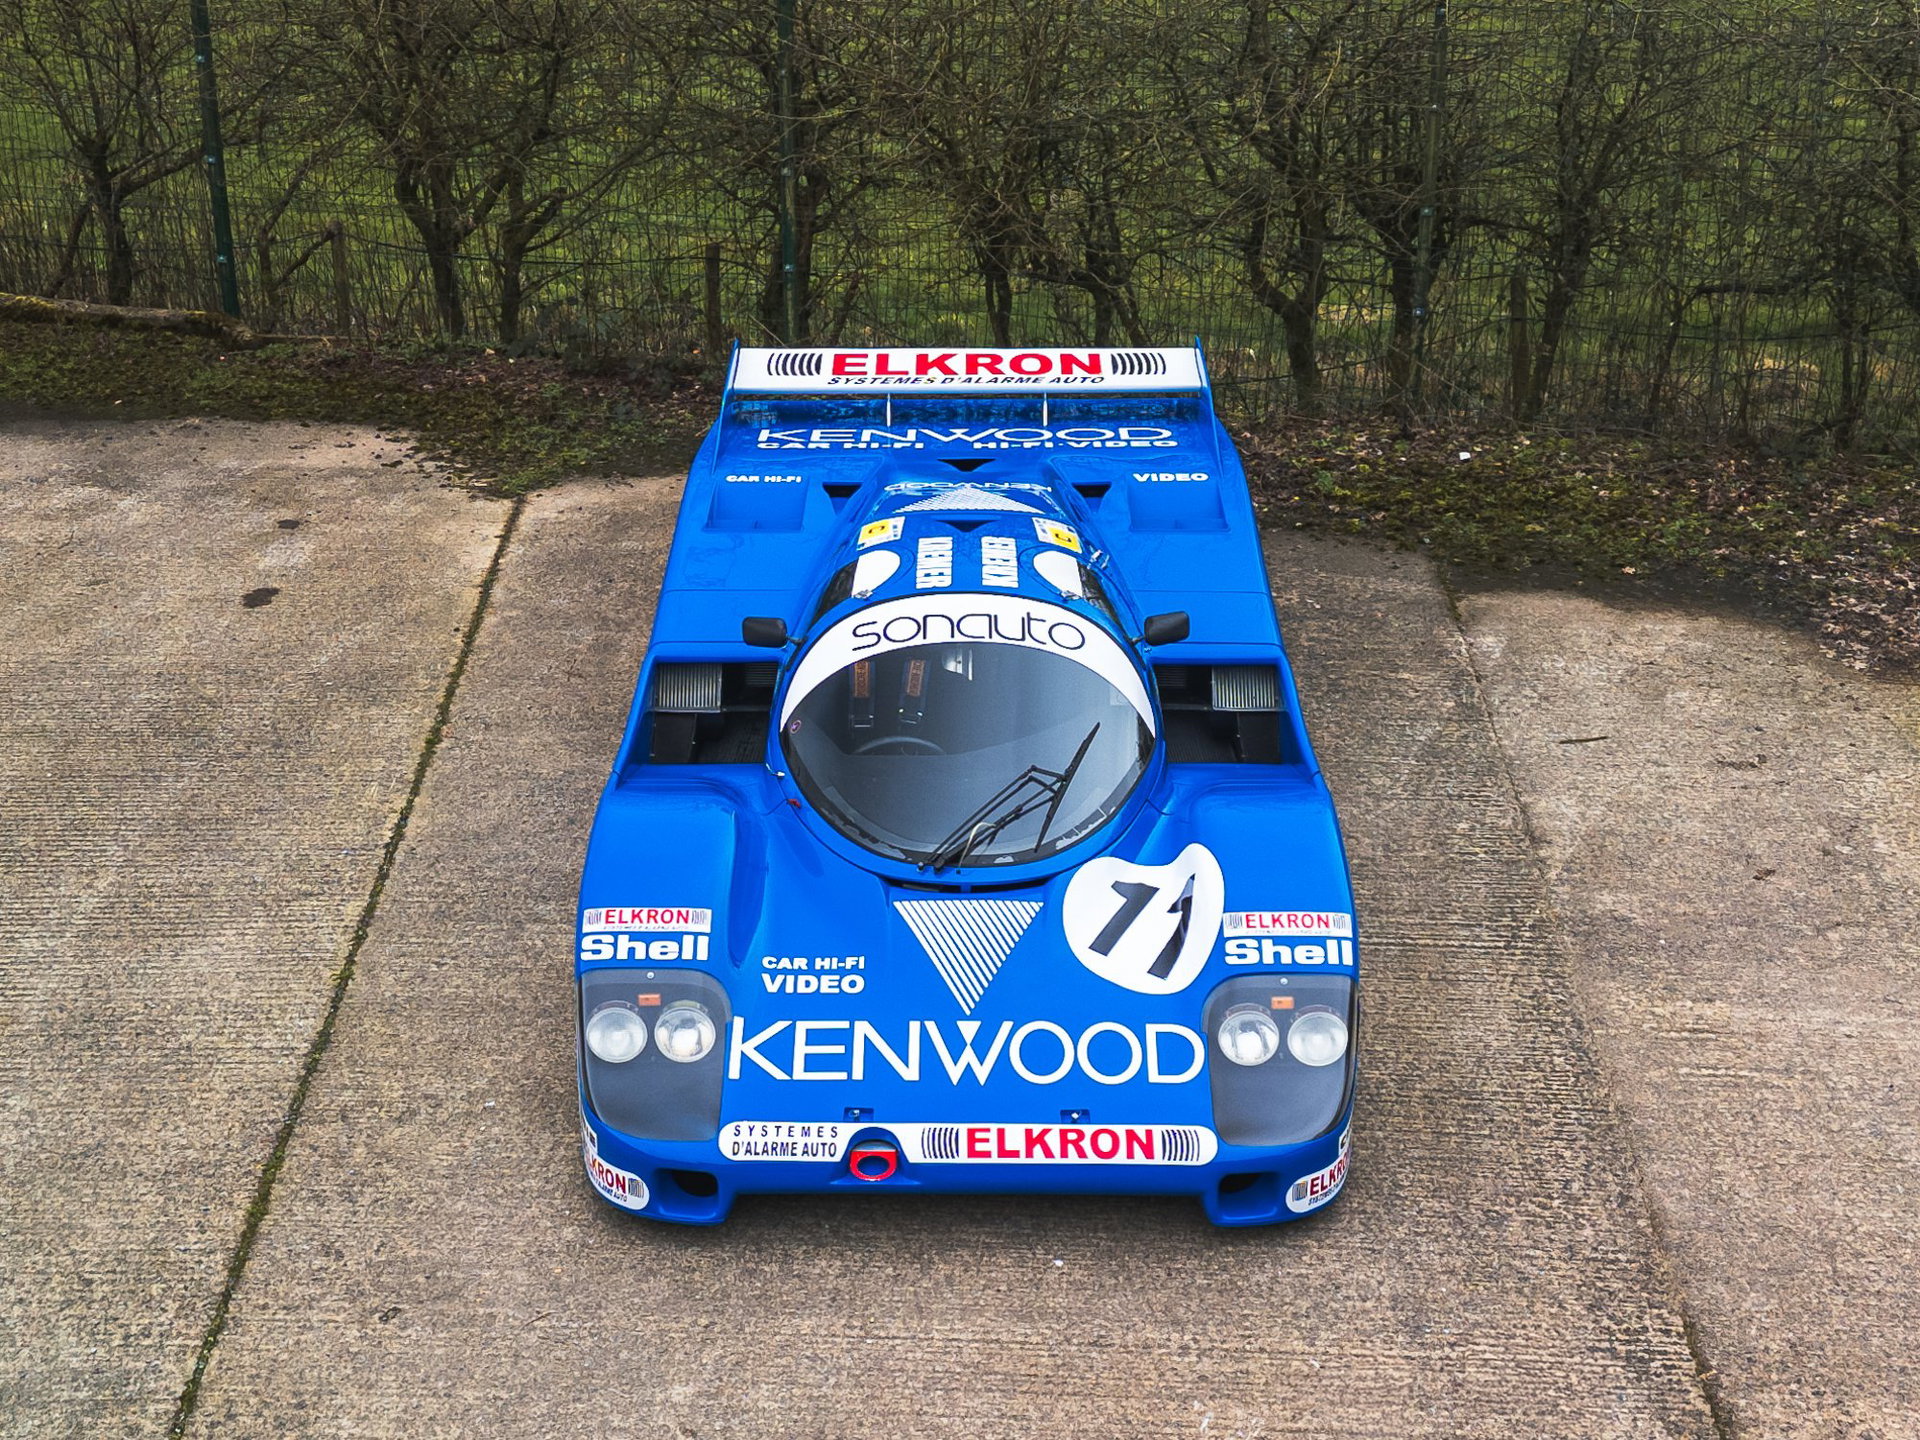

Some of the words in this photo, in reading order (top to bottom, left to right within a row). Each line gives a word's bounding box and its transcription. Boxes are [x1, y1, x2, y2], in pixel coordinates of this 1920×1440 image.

[832, 353, 1102, 376] ELKRON
[828, 376, 935, 385] SYSTEMES
[940, 376, 1046, 385] D'ALARME
[1049, 376, 1105, 385] AUTO
[758, 427, 1173, 443] KENWOOD
[726, 475, 760, 483] CAR
[764, 475, 802, 483] HI-FI
[1133, 473, 1209, 483] VIDEO
[852, 612, 1086, 652] sonauto
[605, 909, 690, 925] ELKRON
[1245, 913, 1331, 929] ELKRON
[1088, 873, 1196, 980] 11
[580, 934, 710, 961] Shell
[1224, 938, 1354, 966] Shell
[761, 956, 808, 971] CAR
[815, 956, 865, 970] HI-FI
[761, 974, 865, 994] VIDEO
[728, 1015, 1206, 1086] KENWOOD
[733, 1124, 838, 1138] SYSTEMES
[732, 1141, 798, 1157] D'ALARME
[801, 1142, 837, 1157] AUTO
[966, 1127, 1155, 1160] ELKRON
